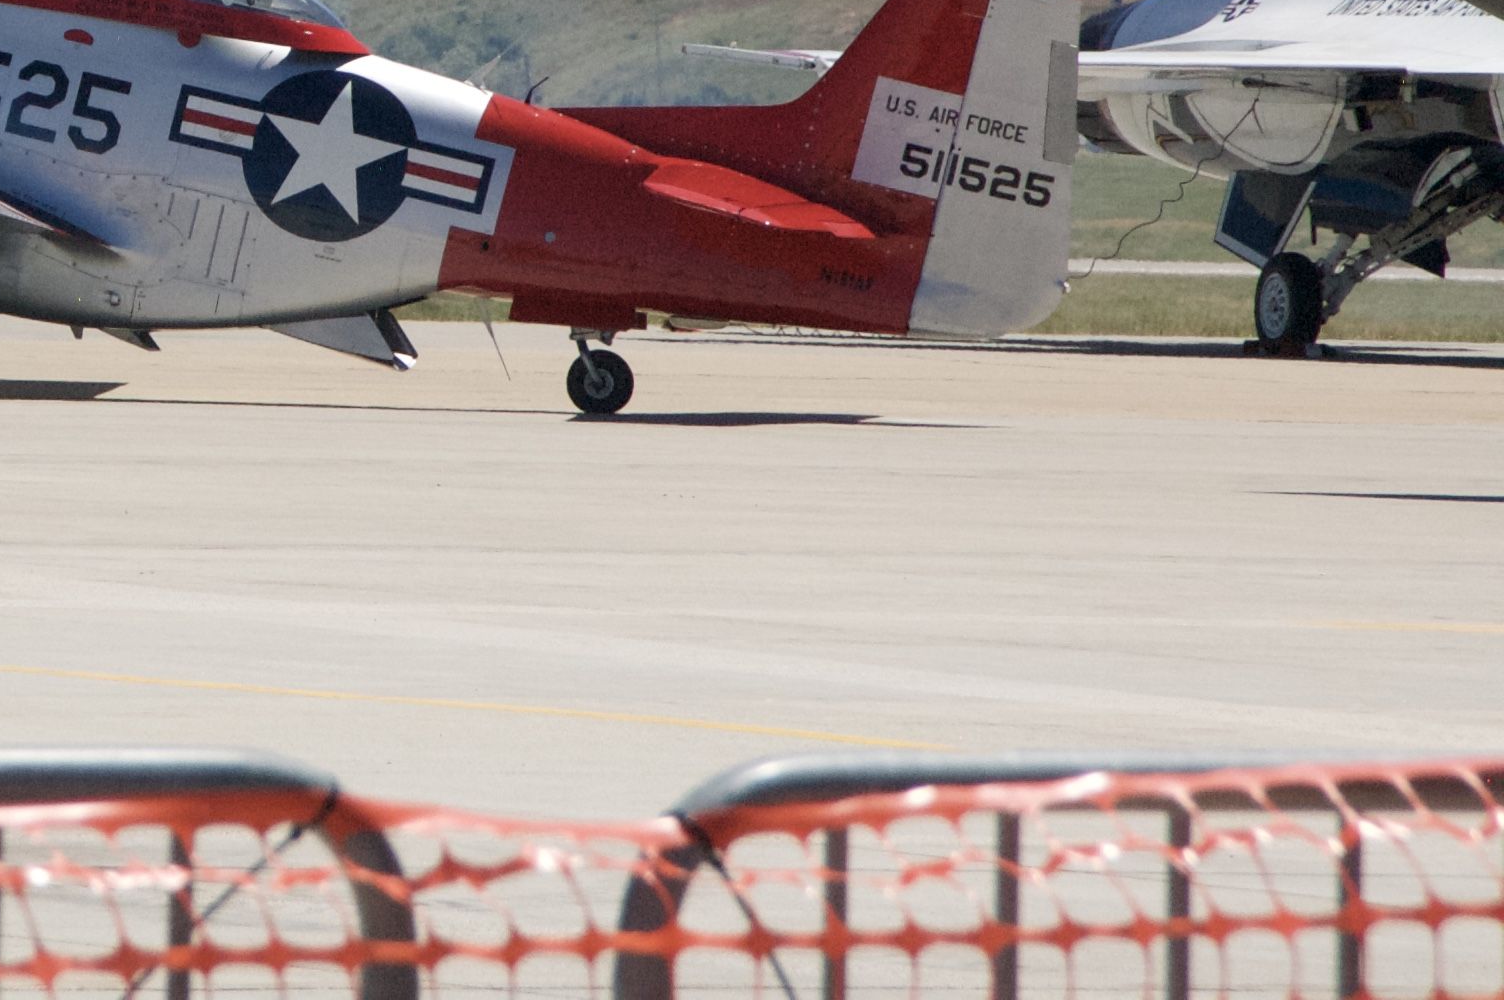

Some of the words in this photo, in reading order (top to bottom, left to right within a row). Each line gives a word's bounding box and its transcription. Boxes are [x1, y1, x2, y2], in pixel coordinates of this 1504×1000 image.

[886, 94, 920, 119] U.S.
[928, 106, 959, 128] AIR
[965, 114, 1029, 144] FORCE
[899, 142, 1056, 208] 511525
